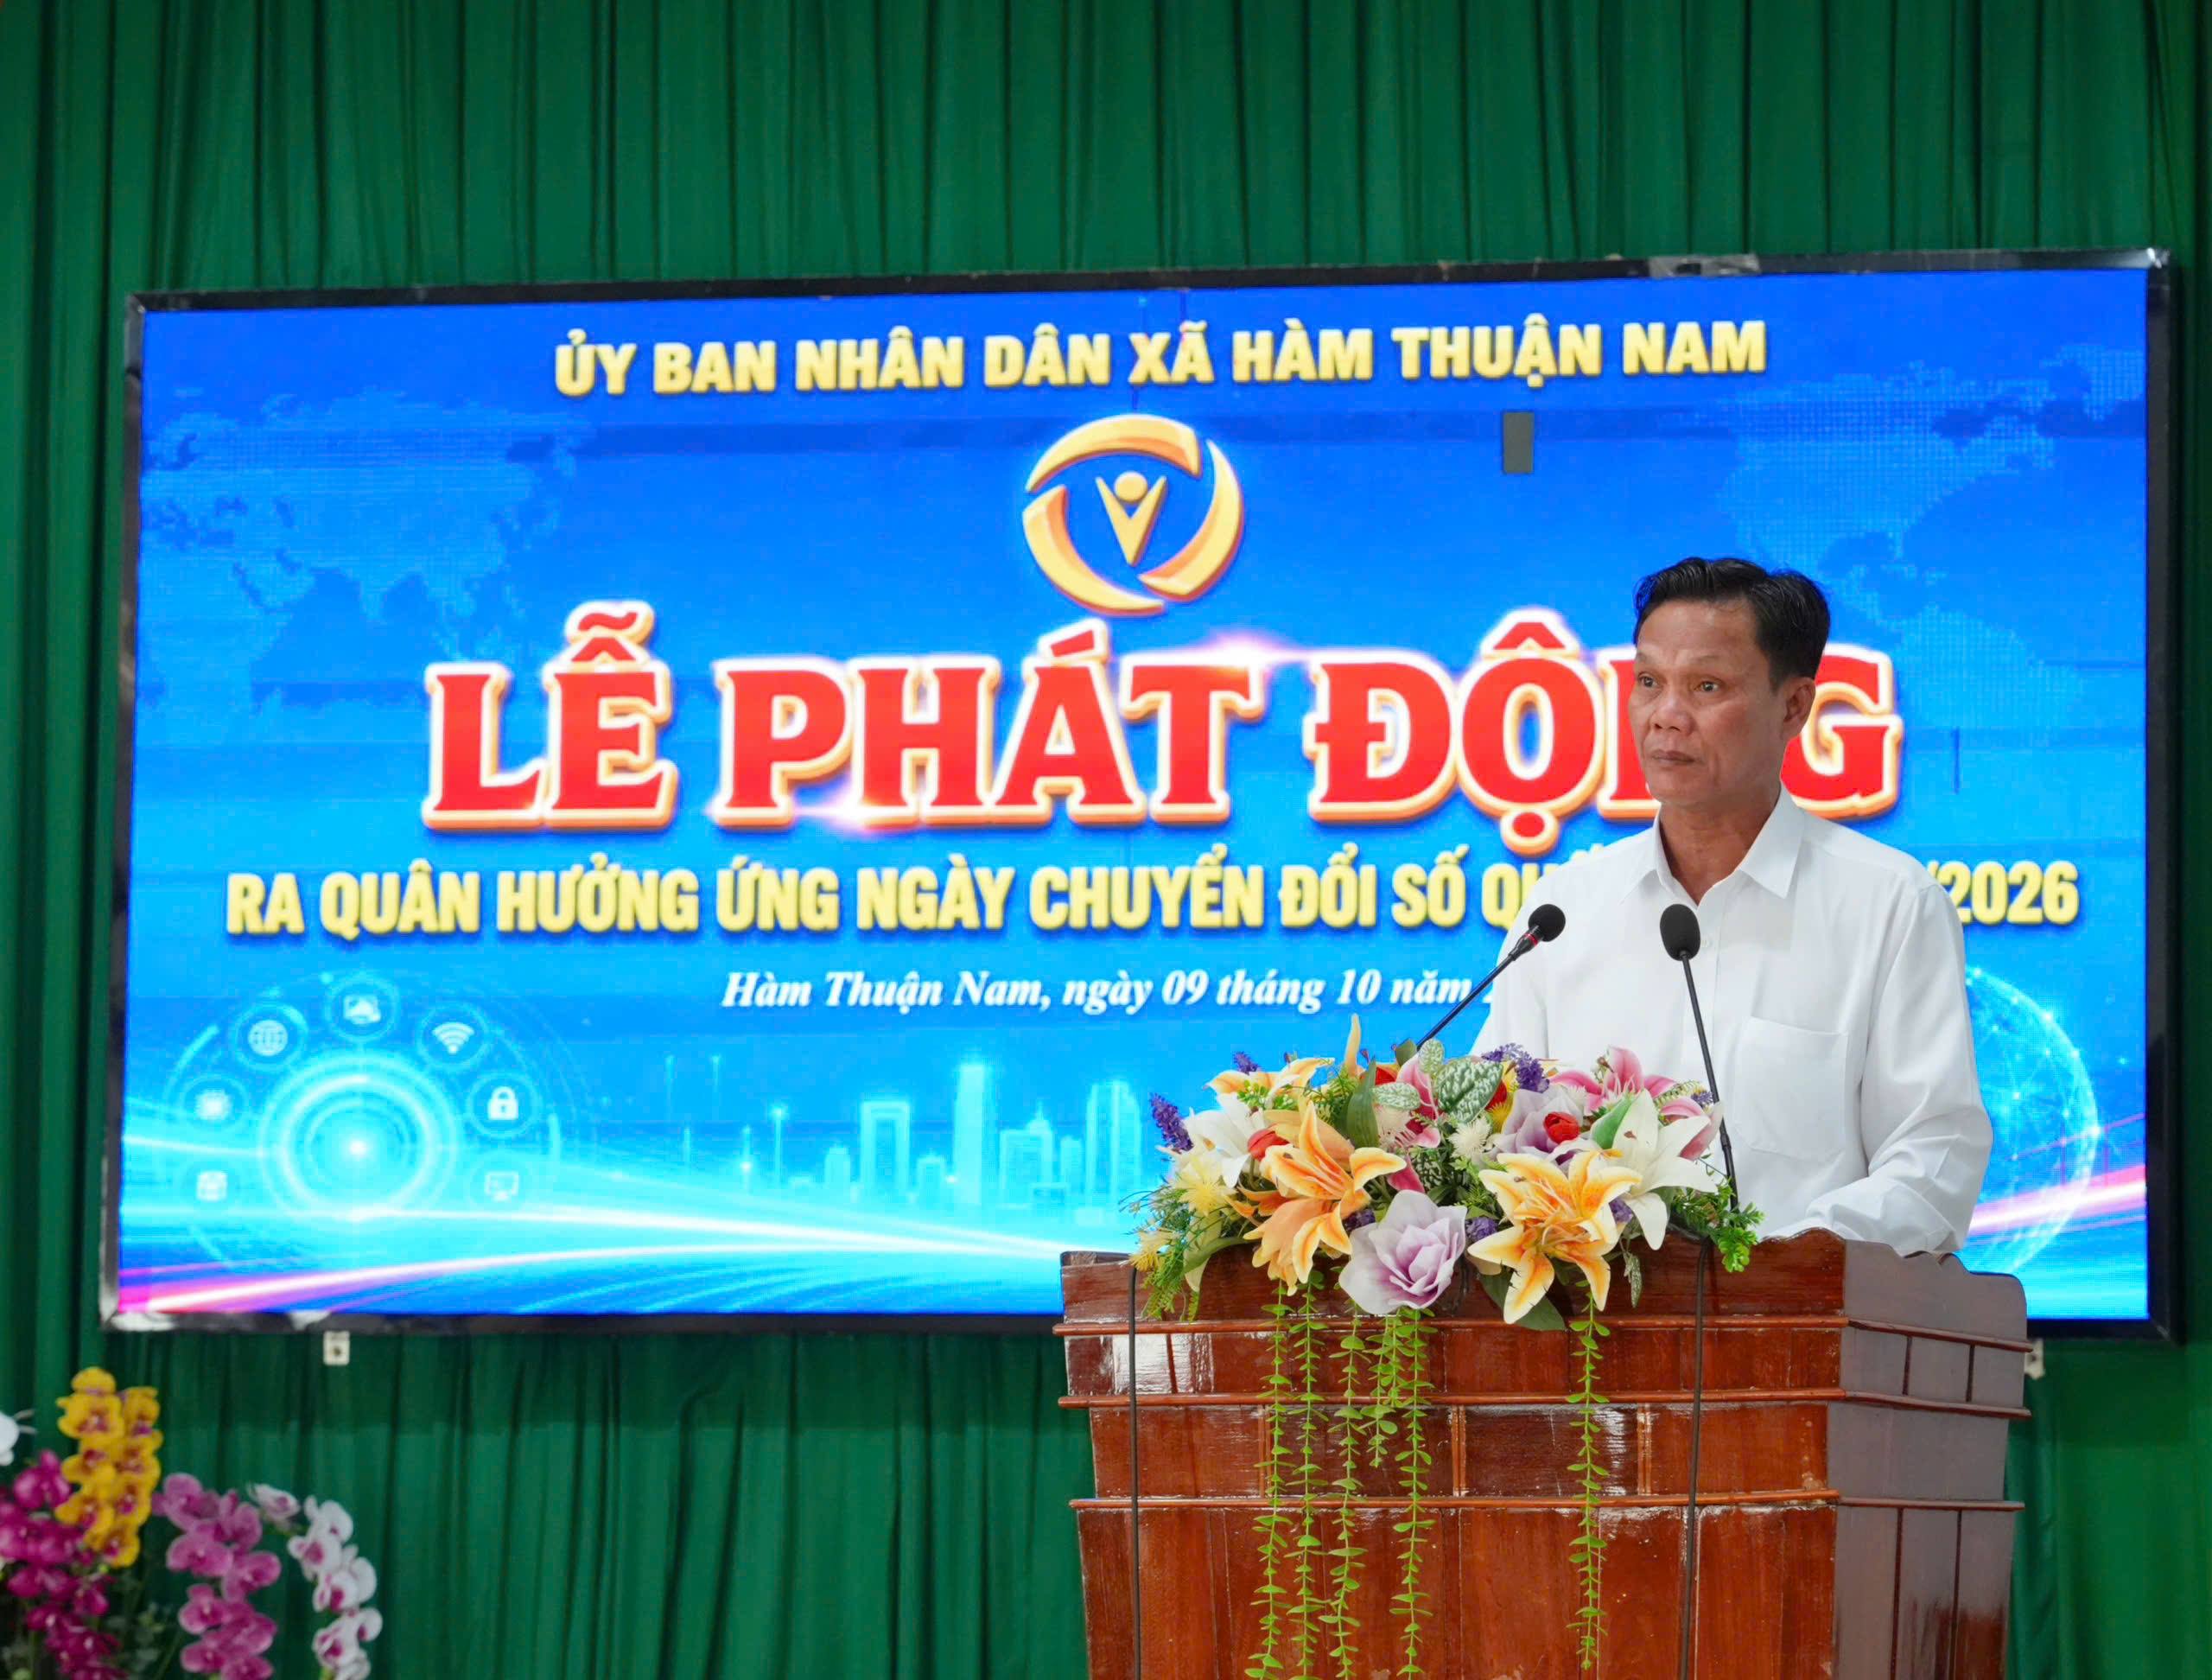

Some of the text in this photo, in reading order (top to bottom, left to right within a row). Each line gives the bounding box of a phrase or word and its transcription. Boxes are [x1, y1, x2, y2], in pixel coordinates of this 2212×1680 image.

[556, 313, 1766, 396] ỦY BAN NHÂN DÂN XÃ HÀM THUẬN NAM
[422, 601, 679, 830] LỄ
[711, 619, 1267, 830] PHÁT
[227, 873, 305, 934] RA
[320, 858, 480, 940] QUÂN
[497, 852, 699, 932] HƯỞNG
[715, 855, 840, 932] ỨNG
[856, 853, 1015, 930] NGÀY
[1029, 843, 1264, 929] CHUYỂN
[1278, 842, 1377, 927] ĐỔI
[1391, 843, 1469, 927] SỐ
[722, 971, 812, 1007] Hàm
[826, 971, 944, 1015] Thuận
[954, 970, 1052, 1010] Nam,
[1063, 970, 1154, 1015] ngày
[1162, 969, 1209, 1004] 09
[1217, 969, 1325, 1014] tháng
[1338, 969, 1382, 1004] 10
[1390, 970, 1472, 1003] năm
